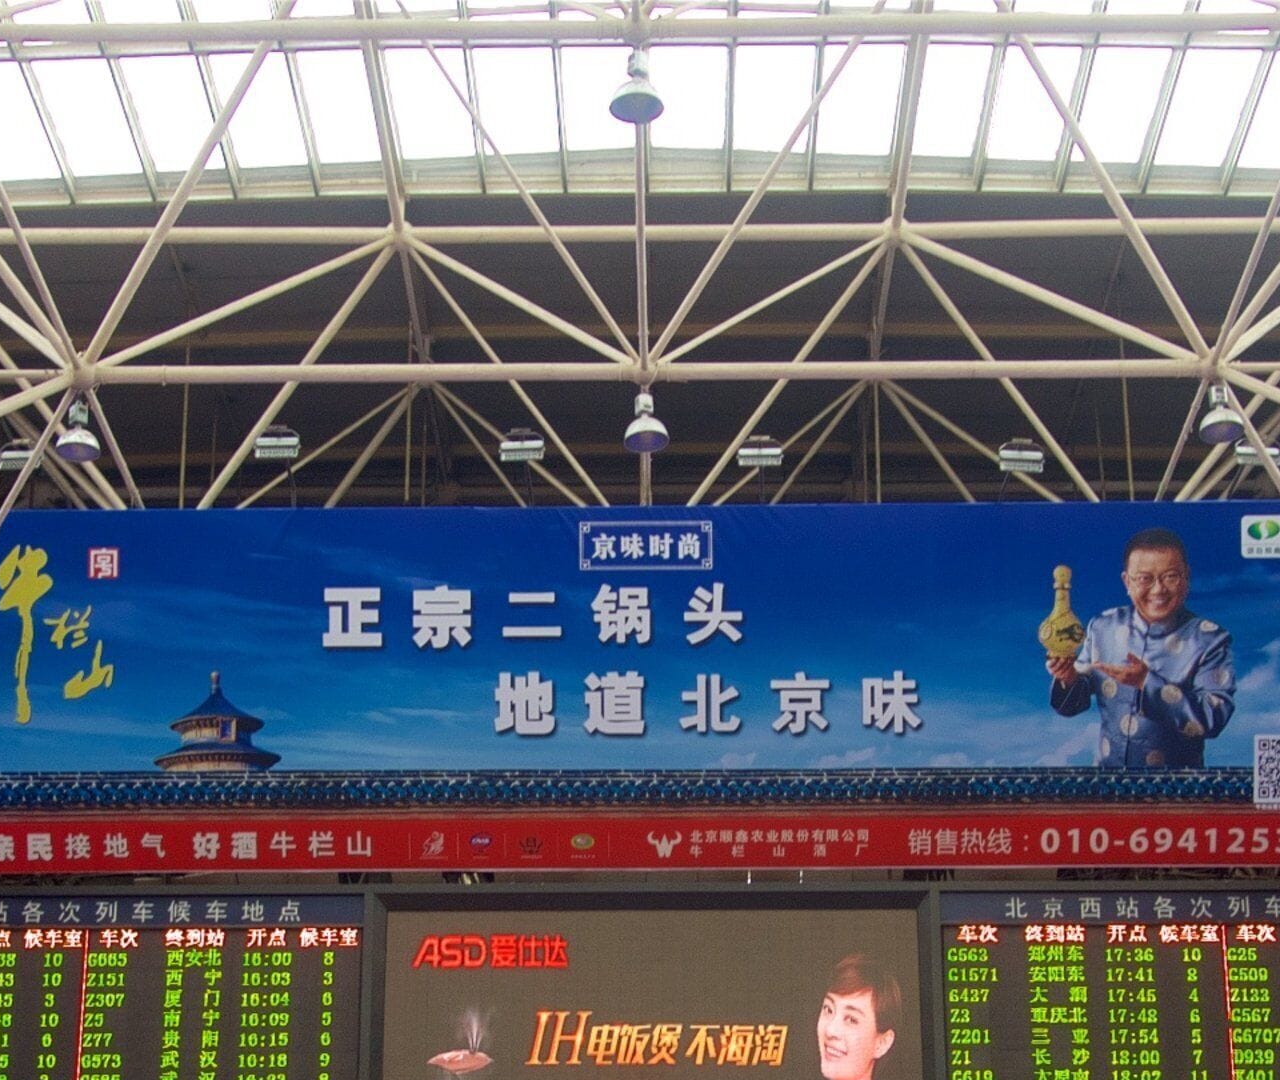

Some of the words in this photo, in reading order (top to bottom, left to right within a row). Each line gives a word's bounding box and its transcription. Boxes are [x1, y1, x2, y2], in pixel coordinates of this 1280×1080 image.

[591, 532, 701, 562] 京味时尚
[322, 582, 742, 648] 正宗二锅头
[494, 671, 926, 739] 地道北京味
[193, 831, 371, 859] 好酒牛栏山
[689, 829, 871, 843] 北京顺鑫农业股份有限公司
[689, 844, 871, 858] 牛栏山酒厂
[24, 928, 82, 948] 候车室
[99, 928, 138, 948] 车次
[164, 928, 224, 948] 终到站
[247, 928, 286, 948] 开点
[300, 928, 358, 948] 候车室
[958, 924, 998, 943] 车次
[1025, 924, 1086, 943] 终到站
[1107, 924, 1147, 943] 开点
[1160, 924, 1220, 943] 候车室
[1236, 924, 1276, 943] 车次
[43, 952, 64, 968] 10
[412, 934, 488, 969] ASD
[490, 935, 568, 968] 爱仕达
[947, 967, 998, 983] G1571
[1028, 964, 1086, 983] 安阳东
[1106, 966, 1155, 983] 17:41
[1186, 967, 1199, 983] 8
[685, 1024, 788, 1067] 不海淘
